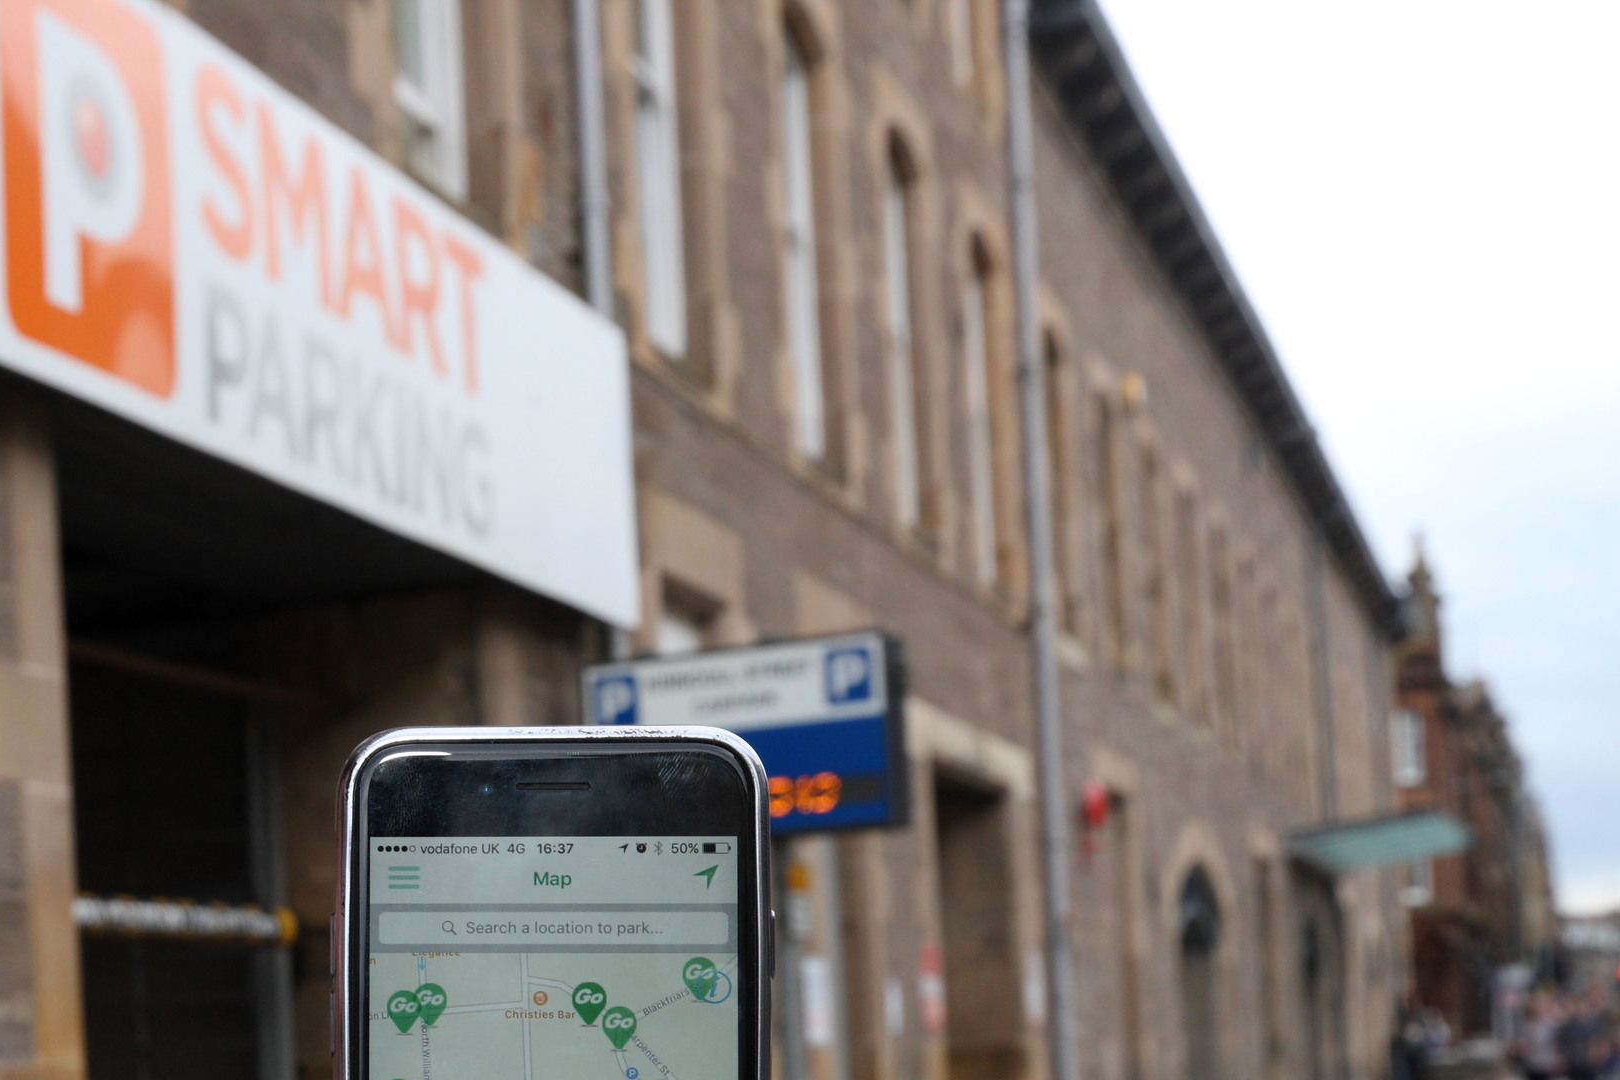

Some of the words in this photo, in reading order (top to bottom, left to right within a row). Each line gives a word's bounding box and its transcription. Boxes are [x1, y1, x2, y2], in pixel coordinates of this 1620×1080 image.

[193, 62, 487, 396] SMART
[203, 279, 493, 540] PARKING
[421, 843, 478, 854] vodafone
[482, 843, 499, 854] UK
[507, 843, 525, 854] 4G
[537, 843, 574, 854] 16:37
[671, 843, 699, 854] 50%
[533, 872, 572, 889] Map
[466, 921, 516, 934] Search
[522, 924, 529, 934] a
[535, 921, 593, 934] location
[598, 922, 612, 934] to
[617, 921, 663, 936] park...
[686, 964, 714, 980] Go
[417, 990, 444, 1005] Go
[575, 988, 603, 1004] Go
[643, 988, 690, 1016] Blackfriars
[390, 997, 418, 1013] Go
[505, 1010, 554, 1019] Christies
[558, 1010, 576, 1019] Bar
[605, 1012, 634, 1029] Go
[660, 1065, 670, 1076] St
